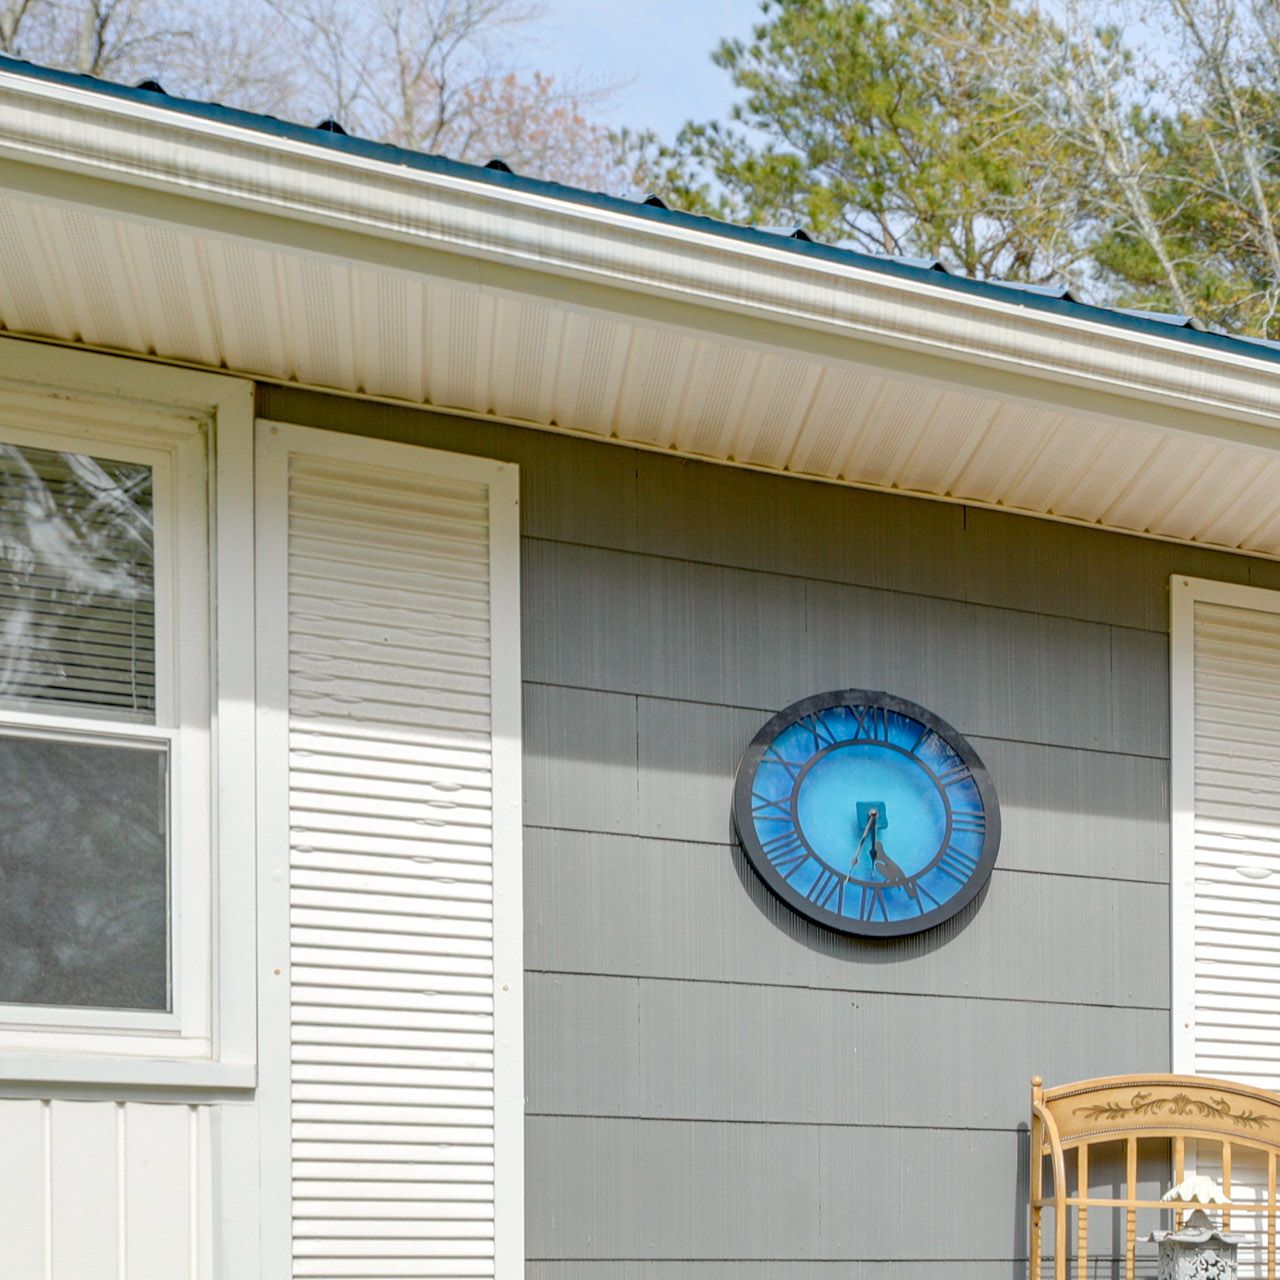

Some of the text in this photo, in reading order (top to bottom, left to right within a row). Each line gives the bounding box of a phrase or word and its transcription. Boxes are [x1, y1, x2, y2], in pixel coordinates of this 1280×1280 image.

[795, 711, 837, 752] XI
[850, 704, 889, 741] XII
[760, 745, 804, 781] X
[952, 810, 986, 834] III
